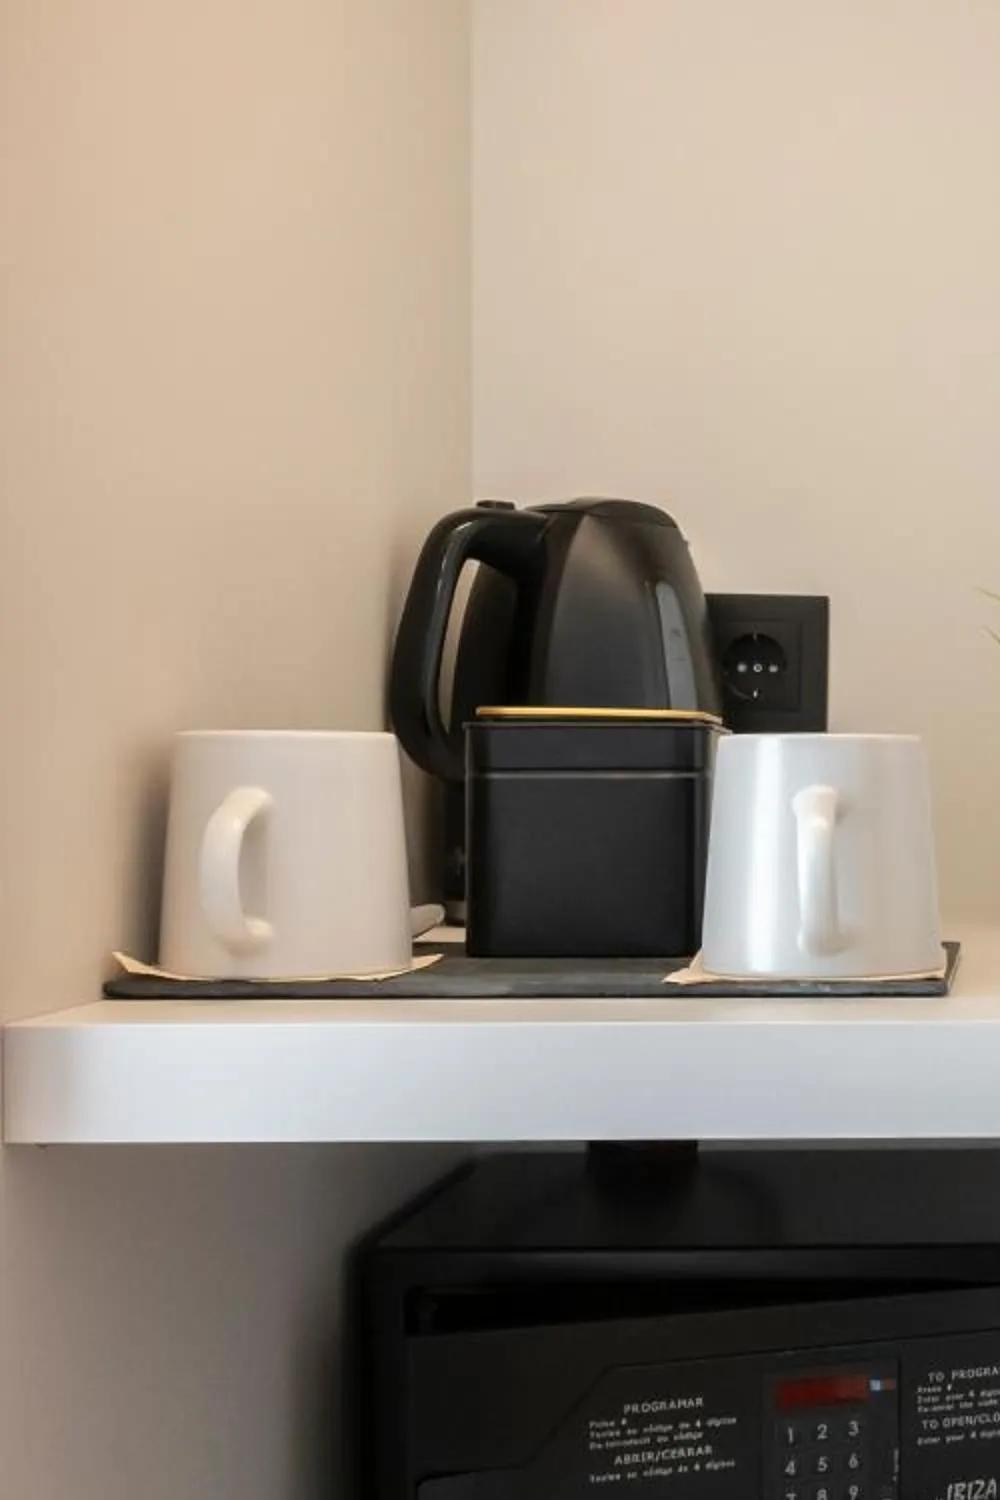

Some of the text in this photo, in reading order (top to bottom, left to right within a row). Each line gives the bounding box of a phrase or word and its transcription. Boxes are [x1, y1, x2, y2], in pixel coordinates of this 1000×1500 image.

[928, 1371, 945, 1384] TO
[623, 1397, 703, 1414] PROGRAMAR
[787, 1420, 860, 1443] 1 2 3
[922, 1419, 939, 1431] TO
[784, 1453, 859, 1476] 4 5 6
[848, 1485, 859, 1500] 9
